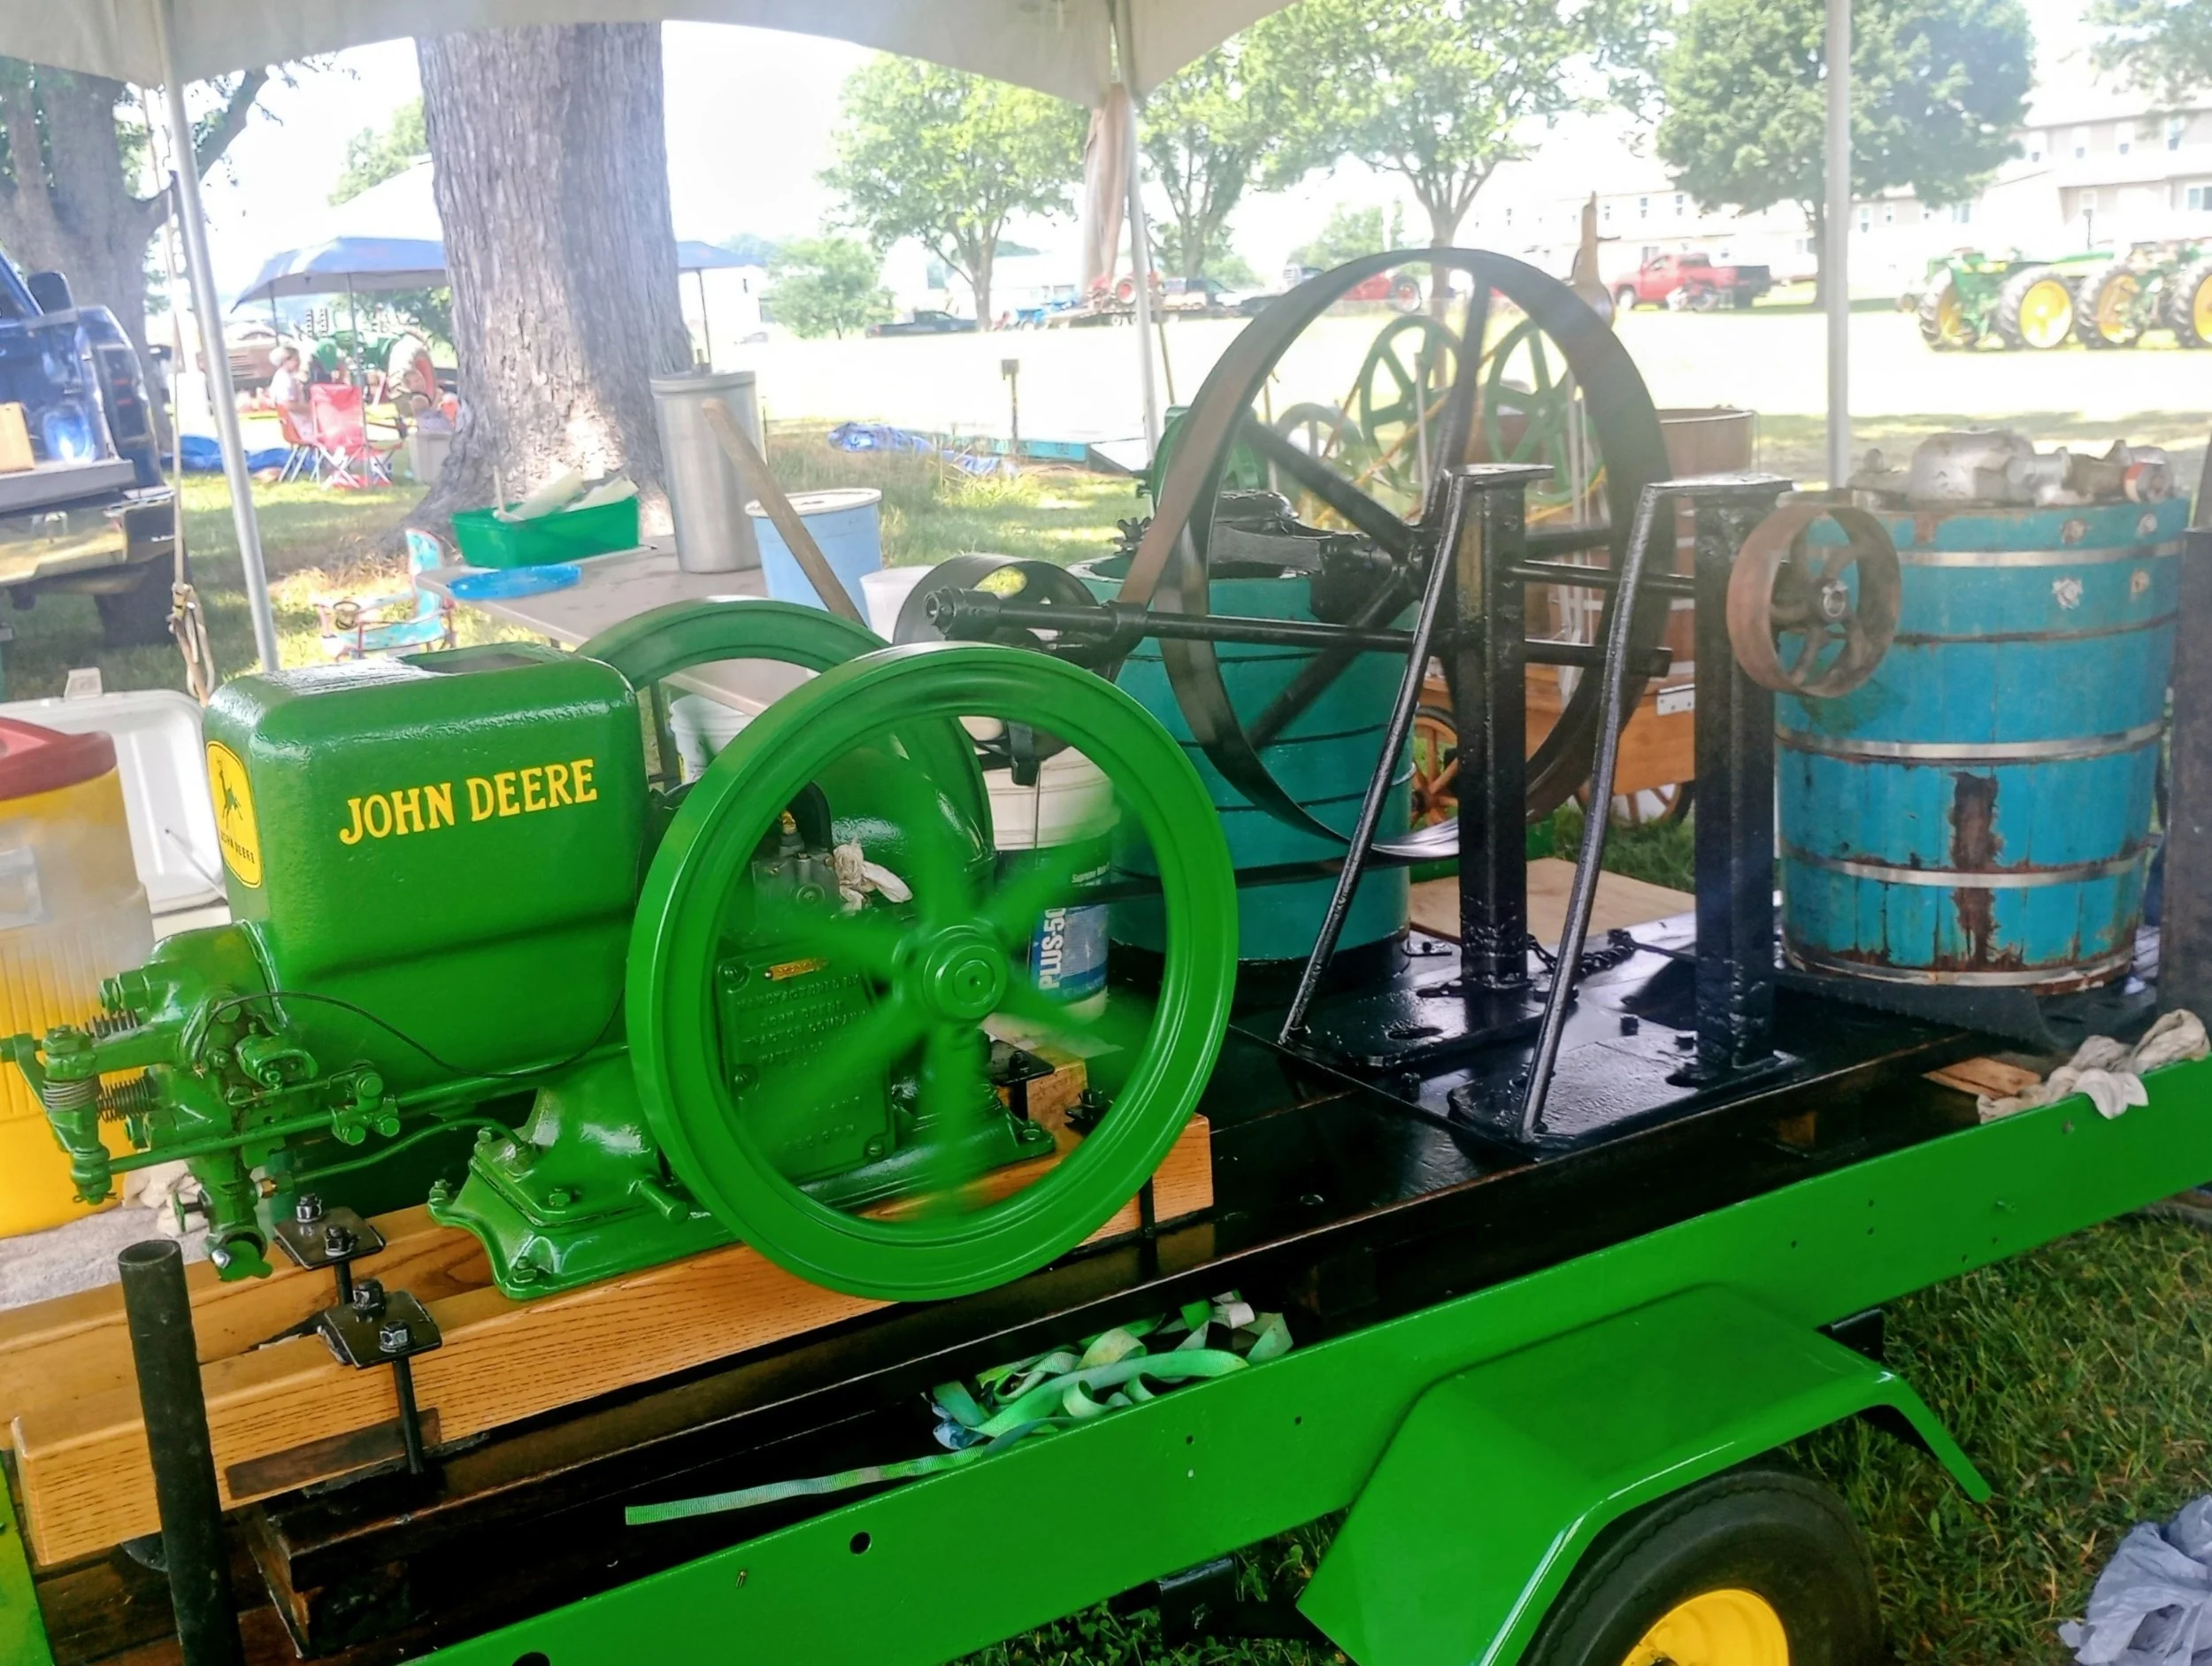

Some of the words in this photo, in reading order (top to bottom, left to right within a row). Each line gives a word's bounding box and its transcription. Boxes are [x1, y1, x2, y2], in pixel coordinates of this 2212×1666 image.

[339, 782, 455, 845] JOHN
[466, 758, 598, 822] DEERE
[234, 841, 255, 864] DEERE
